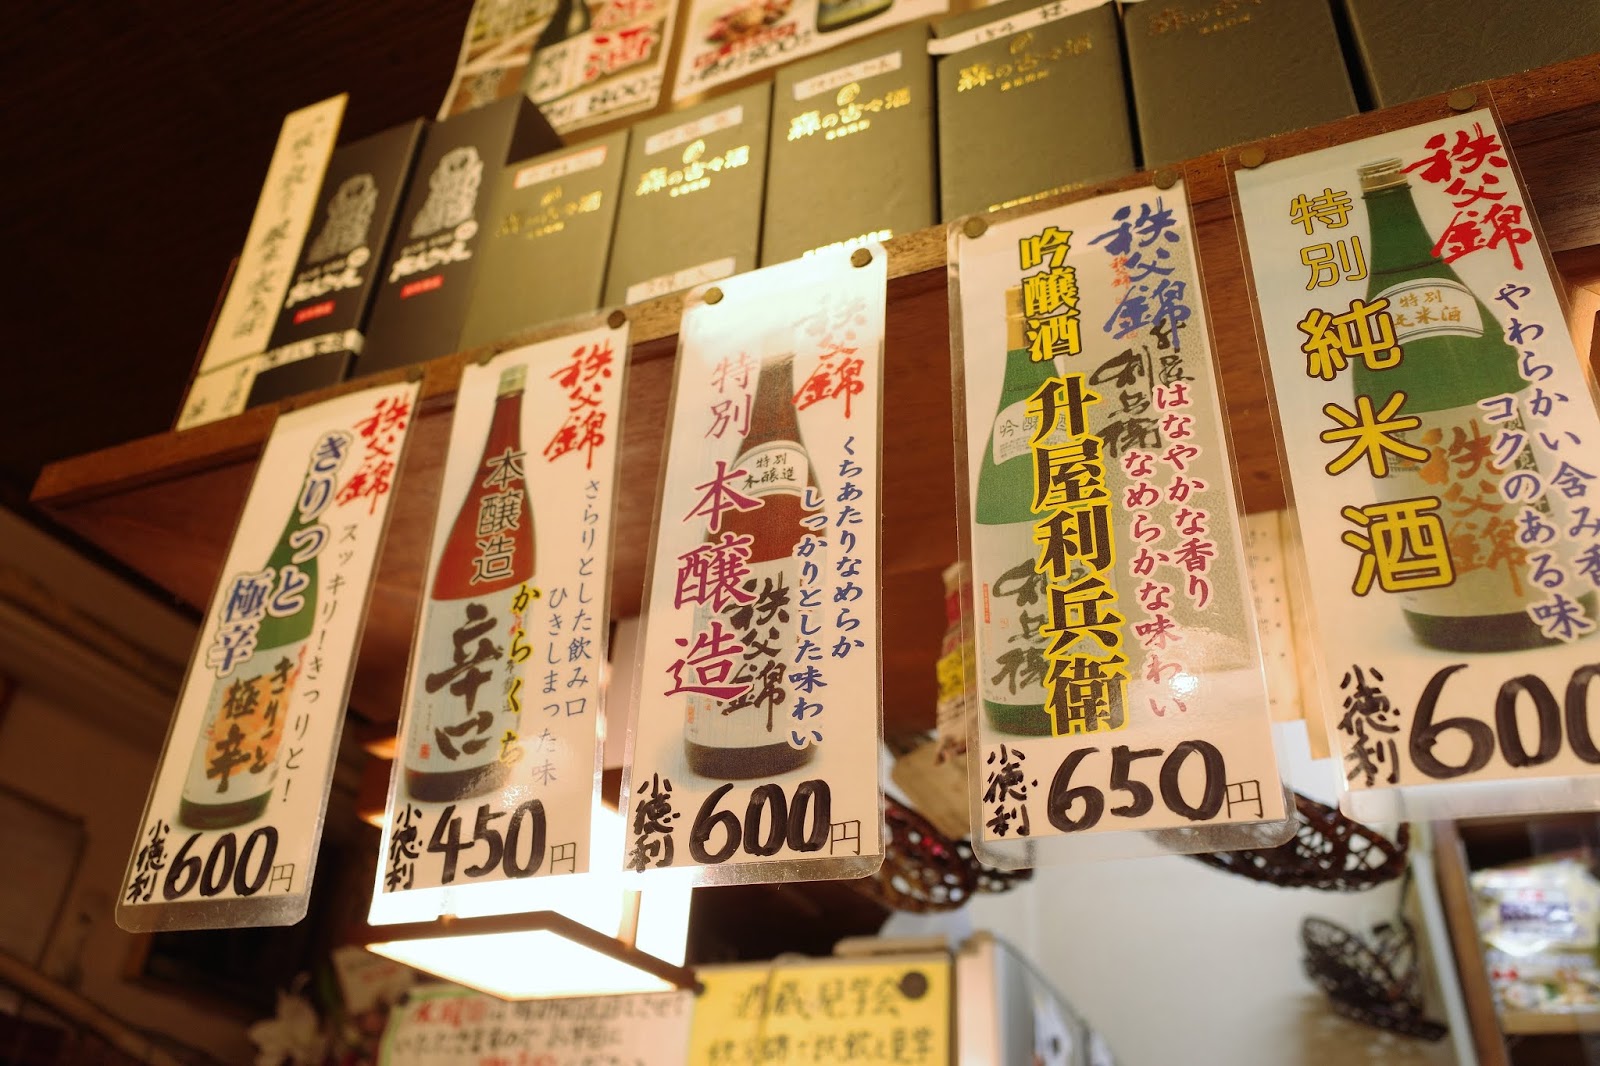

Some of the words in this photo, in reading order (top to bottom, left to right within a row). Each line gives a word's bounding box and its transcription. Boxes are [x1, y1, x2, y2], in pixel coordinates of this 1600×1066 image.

[1087, 196, 1192, 349] 秩父錦
[1399, 122, 1533, 271] 秩父錦
[1018, 225, 1083, 363] 吟醸酒
[335, 391, 411, 516] 秩父錦
[542, 343, 614, 470] 秩父錦
[1289, 187, 1456, 598] 特別純米酒
[469, 448, 527, 586] 本醸造
[663, 351, 763, 700] 特別本醸造
[831, 435, 865, 658] くちあたりなめらか
[1026, 374, 1132, 738] 升屋利兵衛
[1156, 383, 1214, 608] はなやかな香り
[1481, 395, 1592, 639] コクのある味
[207, 570, 272, 674] 極辛
[565, 478, 601, 718] さらりとした飲み口
[788, 489, 829, 747] しっかりとした味わい
[1123, 451, 1187, 717] なめらかな味わい
[500, 583, 541, 766] からくち
[531, 587, 568, 787] ひきしまった味
[162, 825, 296, 901] 600円
[426, 798, 578, 885] 450円
[688, 778, 862, 865] 600円
[1047, 739, 1263, 834] 650円
